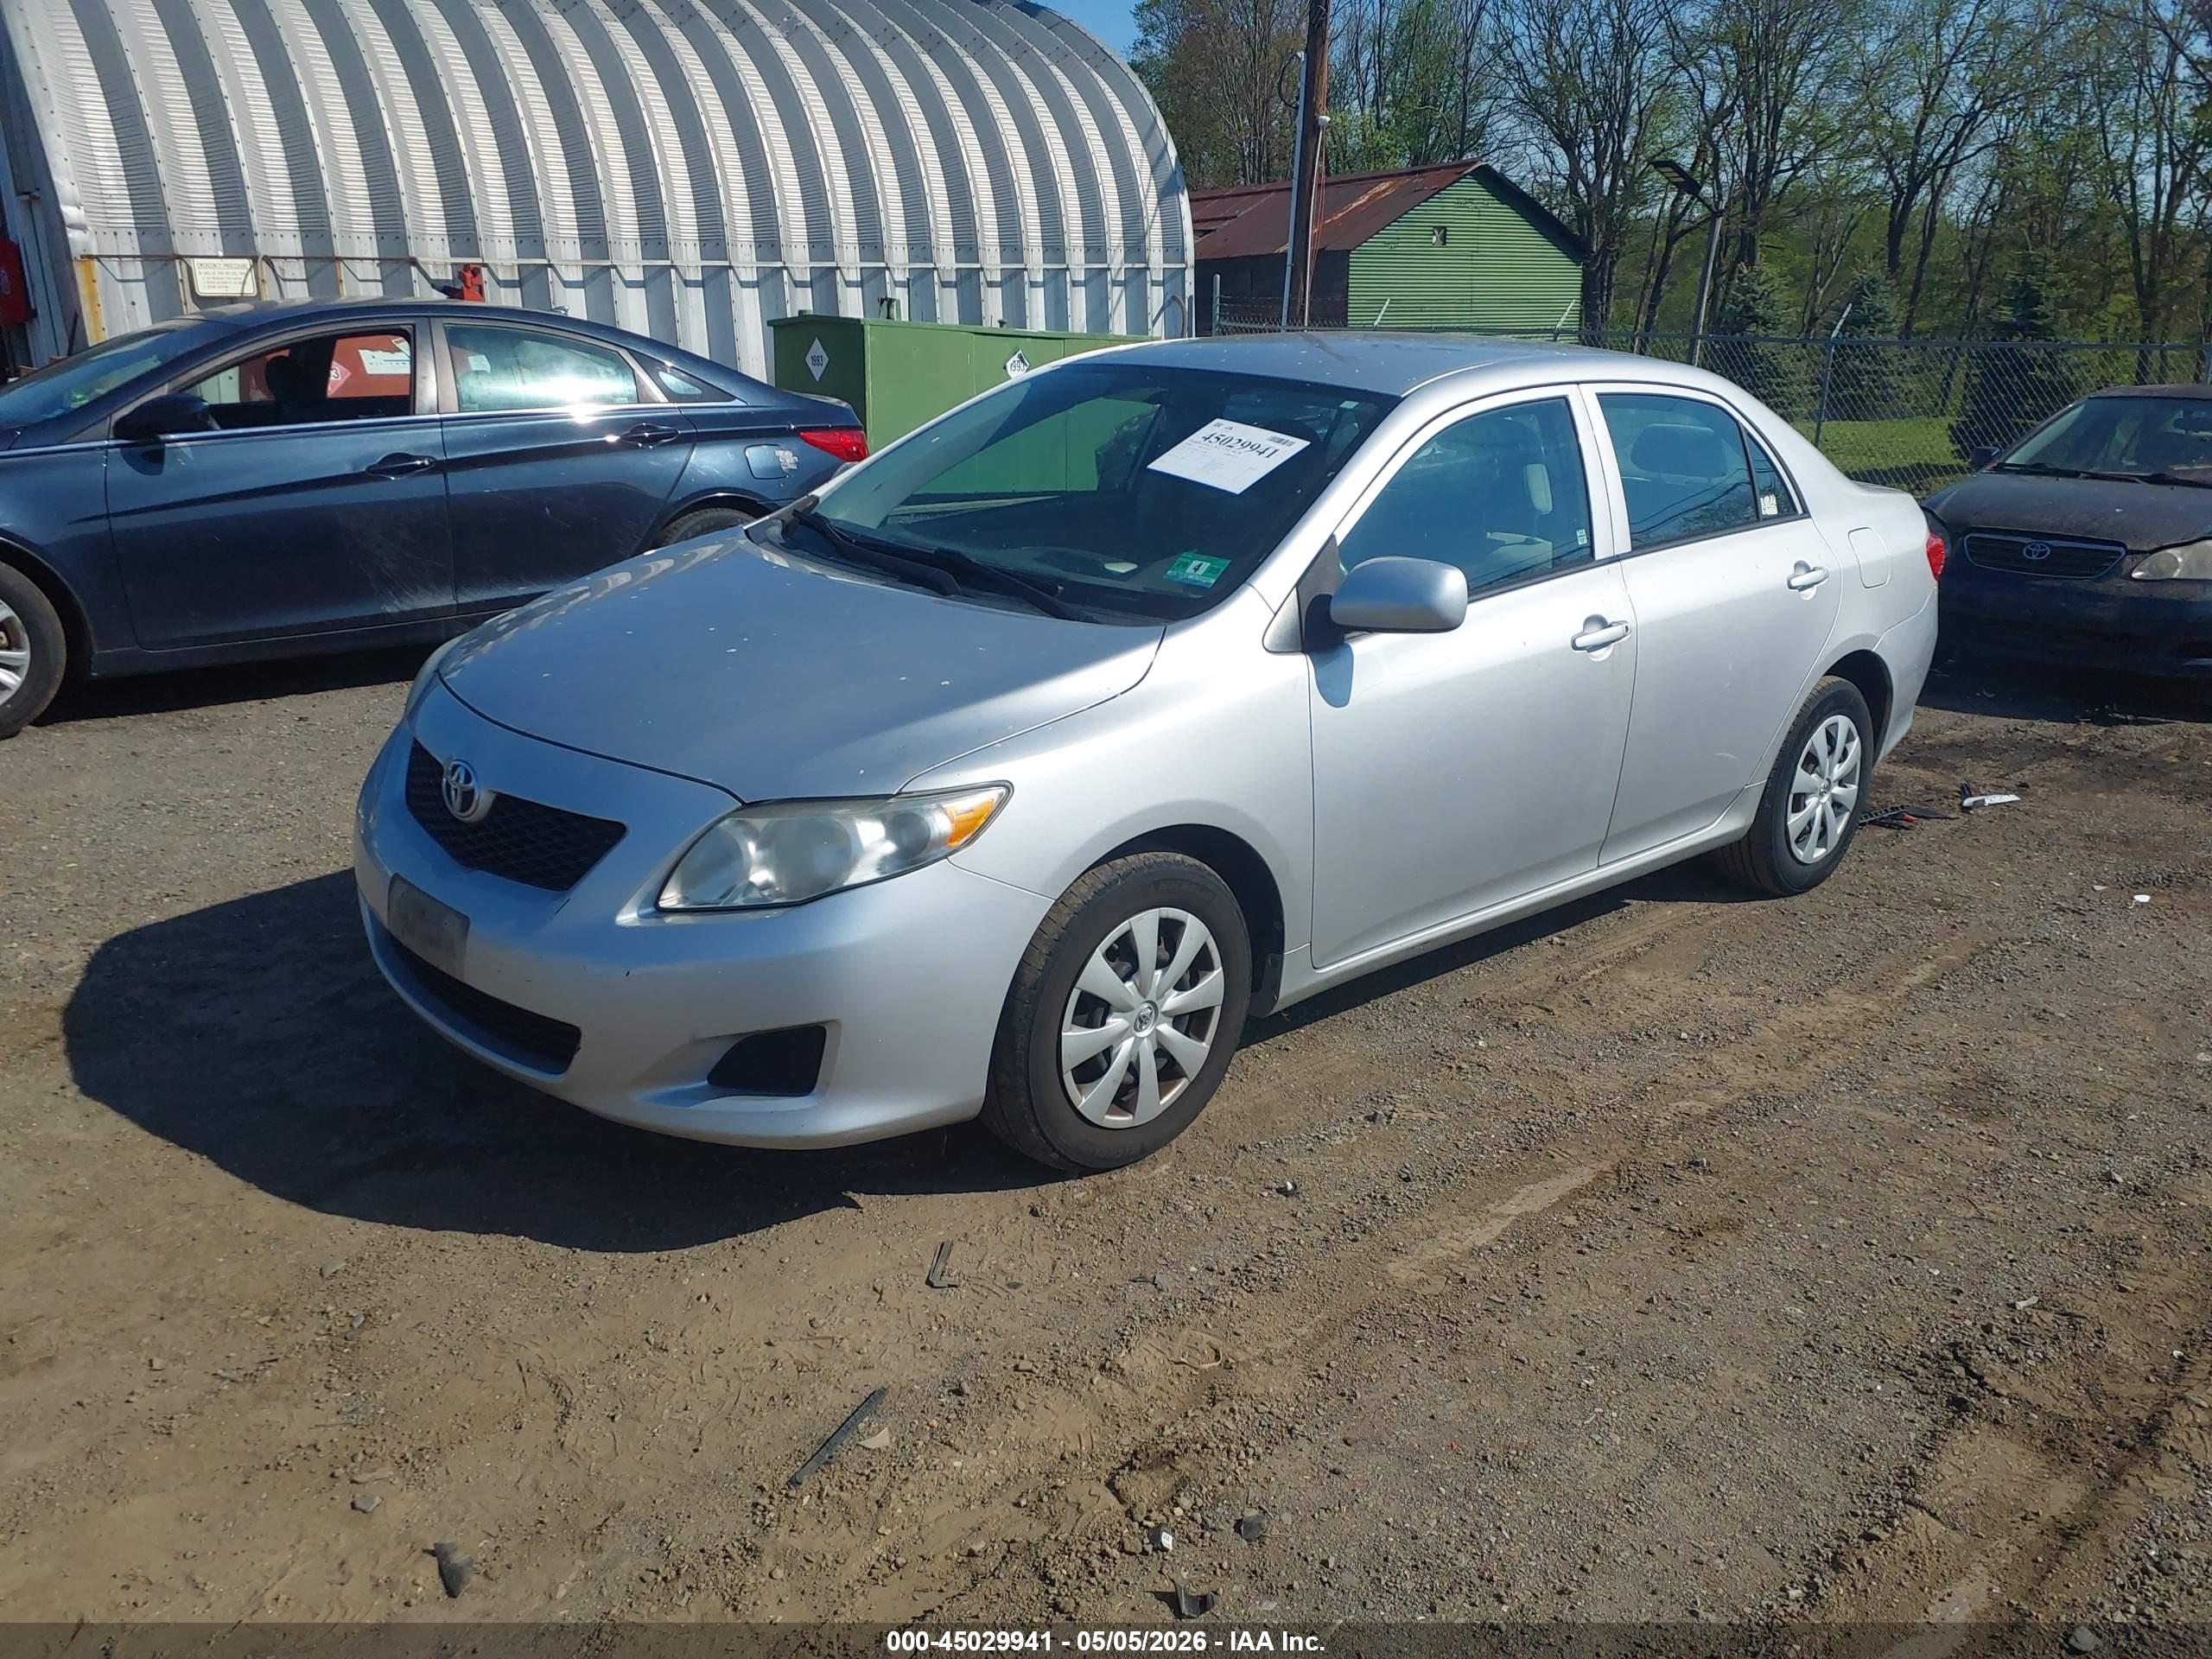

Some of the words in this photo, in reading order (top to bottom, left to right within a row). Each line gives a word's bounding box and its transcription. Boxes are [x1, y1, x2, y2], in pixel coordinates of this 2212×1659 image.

[810, 354, 823, 367] 1993
[1202, 432, 1280, 459] 45029941
[1192, 562, 1203, 573] 4
